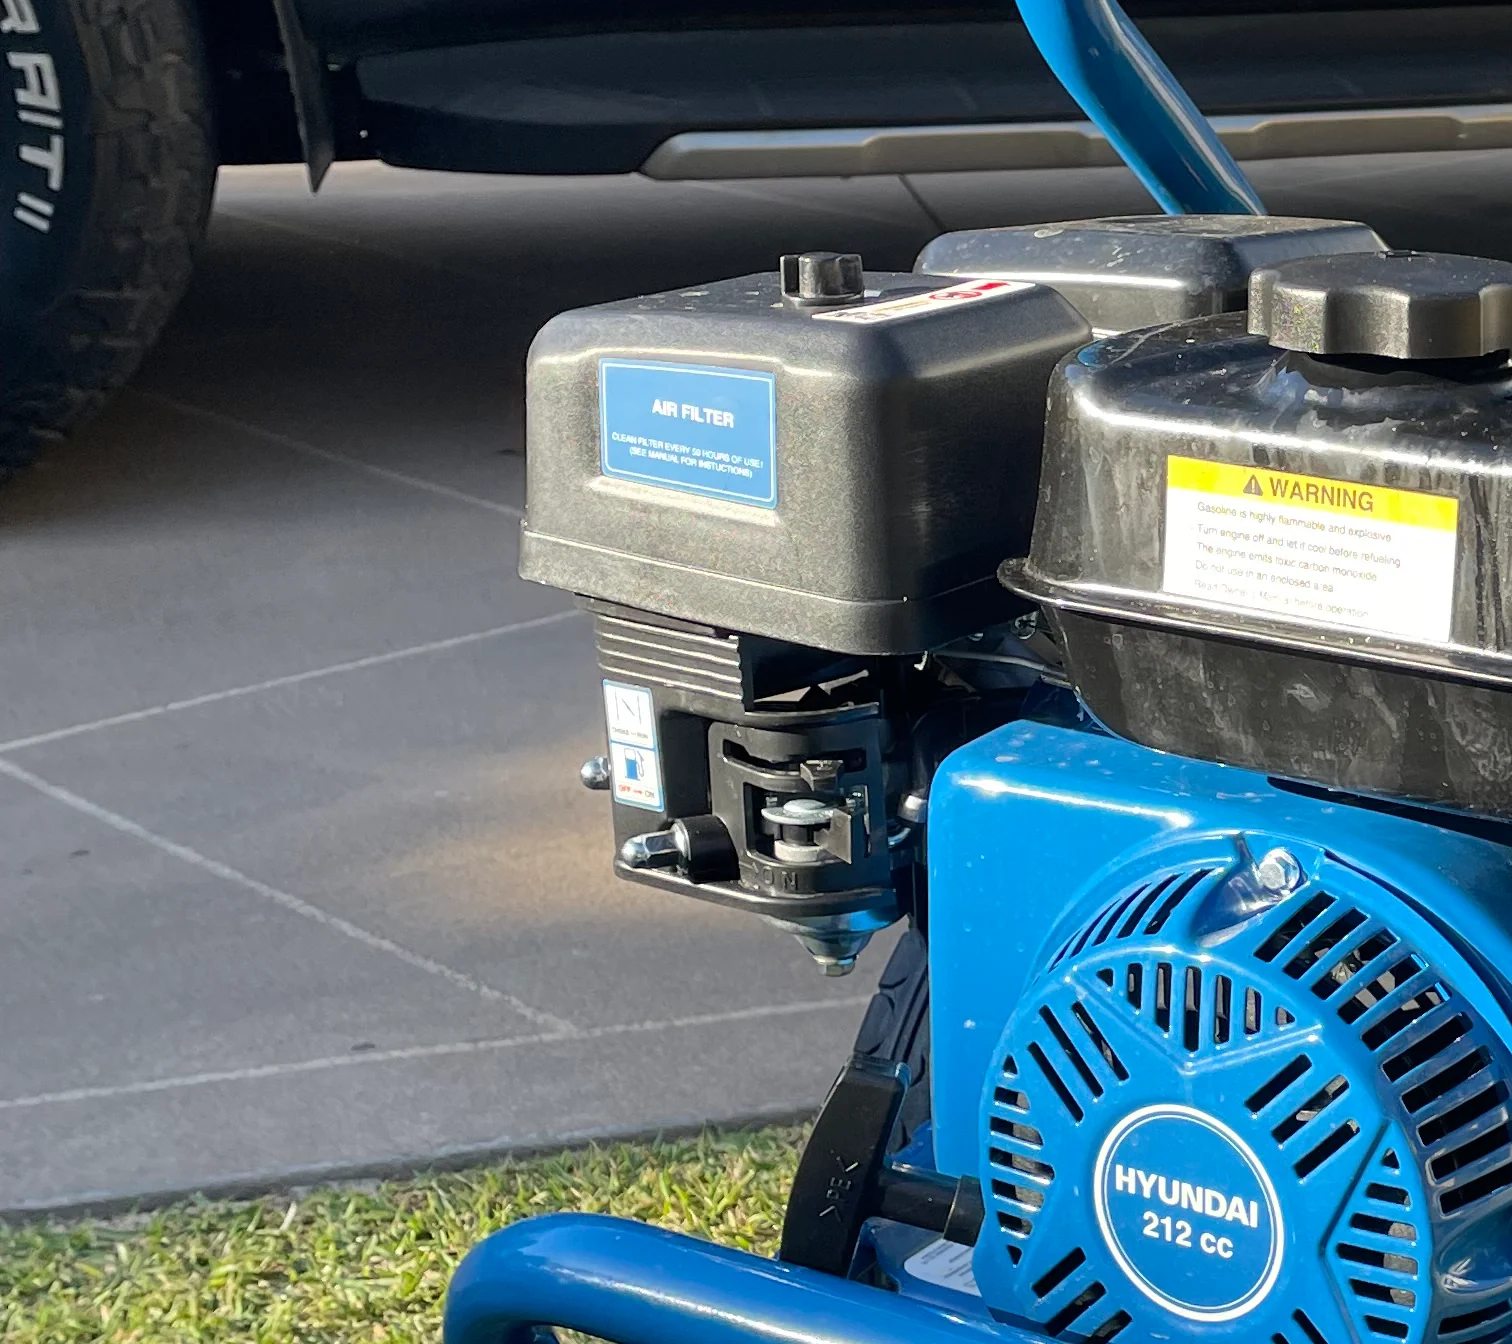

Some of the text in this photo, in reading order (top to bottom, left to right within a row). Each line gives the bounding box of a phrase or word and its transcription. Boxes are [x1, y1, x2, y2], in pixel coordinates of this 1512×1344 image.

[652, 399, 734, 428] AIR FILTER
[612, 432, 637, 445] CLEAN
[638, 437, 663, 449] FILTER
[665, 442, 690, 455] EVERY
[702, 450, 730, 462] HOURS
[731, 455, 742, 464] OF
[648, 450, 679, 465] MANUAL
[680, 456, 697, 467] FOR
[1269, 476, 1374, 512] WARNING
[1197, 501, 1392, 542] Gasoline is highly flammable and explosive
[1197, 524, 1218, 535] Turn
[1220, 529, 1250, 541] engine
[1252, 533, 1265, 543] off
[1266, 536, 1284, 547] and
[1286, 539, 1299, 550] let
[1307, 544, 1327, 554] cool
[1328, 545, 1358, 559] before
[1360, 552, 1401, 568] refueling
[1197, 542, 1377, 582] The engine emits toxic carbon monoxide
[1195, 560, 1209, 571] Do
[1227, 567, 1244, 577] use
[1256, 571, 1268, 581] an
[1270, 573, 1311, 589] enclosed
[1313, 582, 1334, 593] aea
[1115, 1164, 1258, 1228] HYUNDAI
[1142, 1211, 1234, 1258] 212 cc
